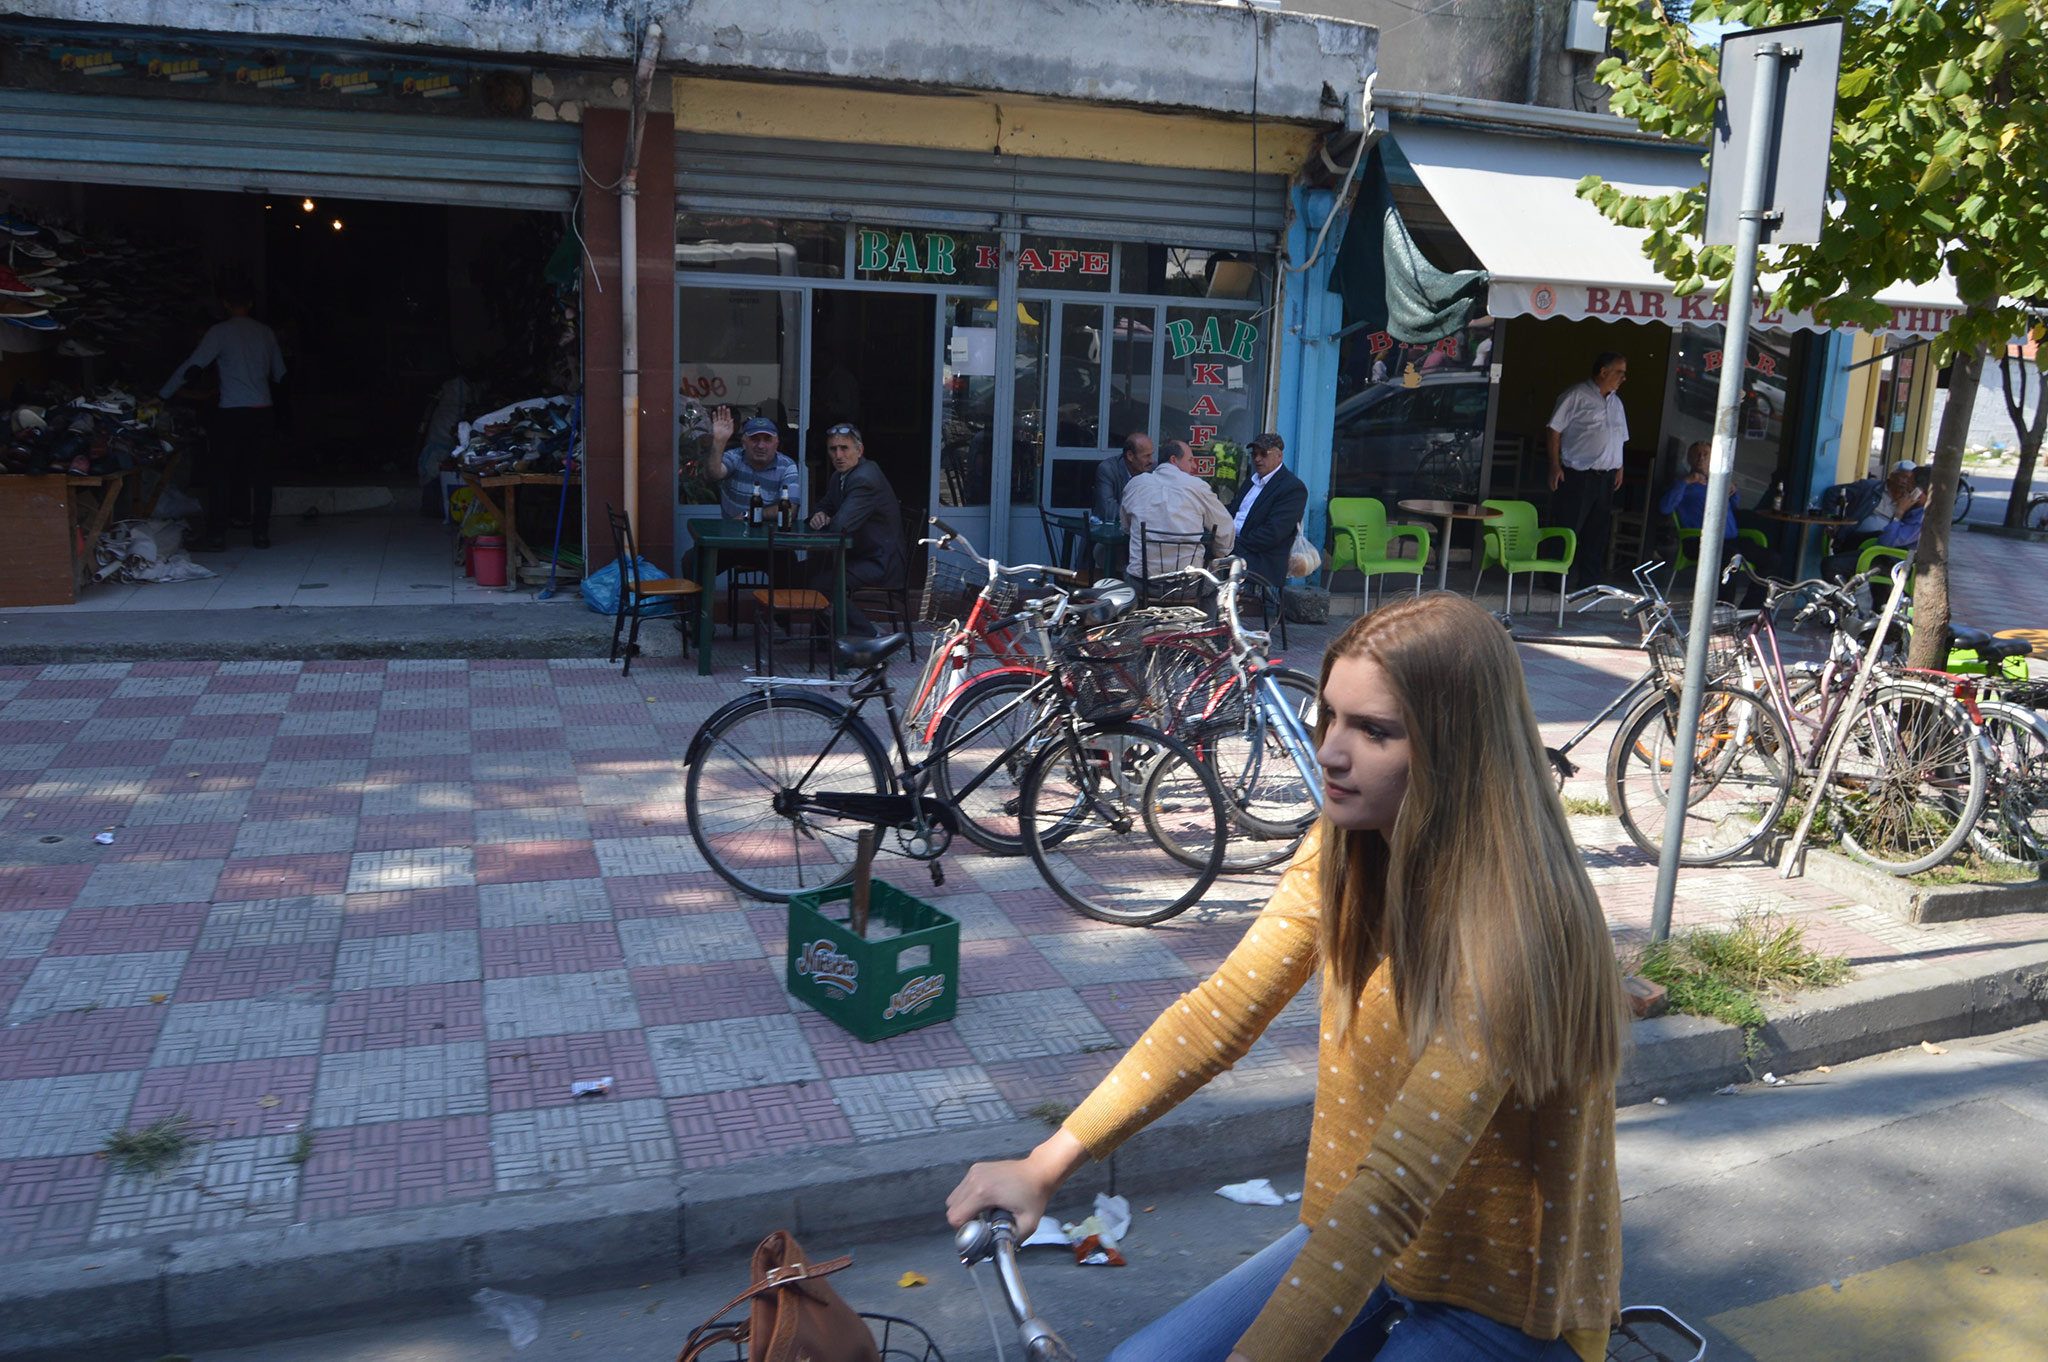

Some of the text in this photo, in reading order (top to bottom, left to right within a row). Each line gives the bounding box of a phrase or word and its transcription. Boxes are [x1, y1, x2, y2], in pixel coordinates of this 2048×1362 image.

[858, 229, 1110, 275] BAR KAFE
[1584, 287, 1667, 318] BAR
[1678, 294, 1784, 324] KAE
[1166, 316, 1258, 362] BAR
[1367, 331, 1458, 358] BR
[1703, 350, 1776, 377] BR
